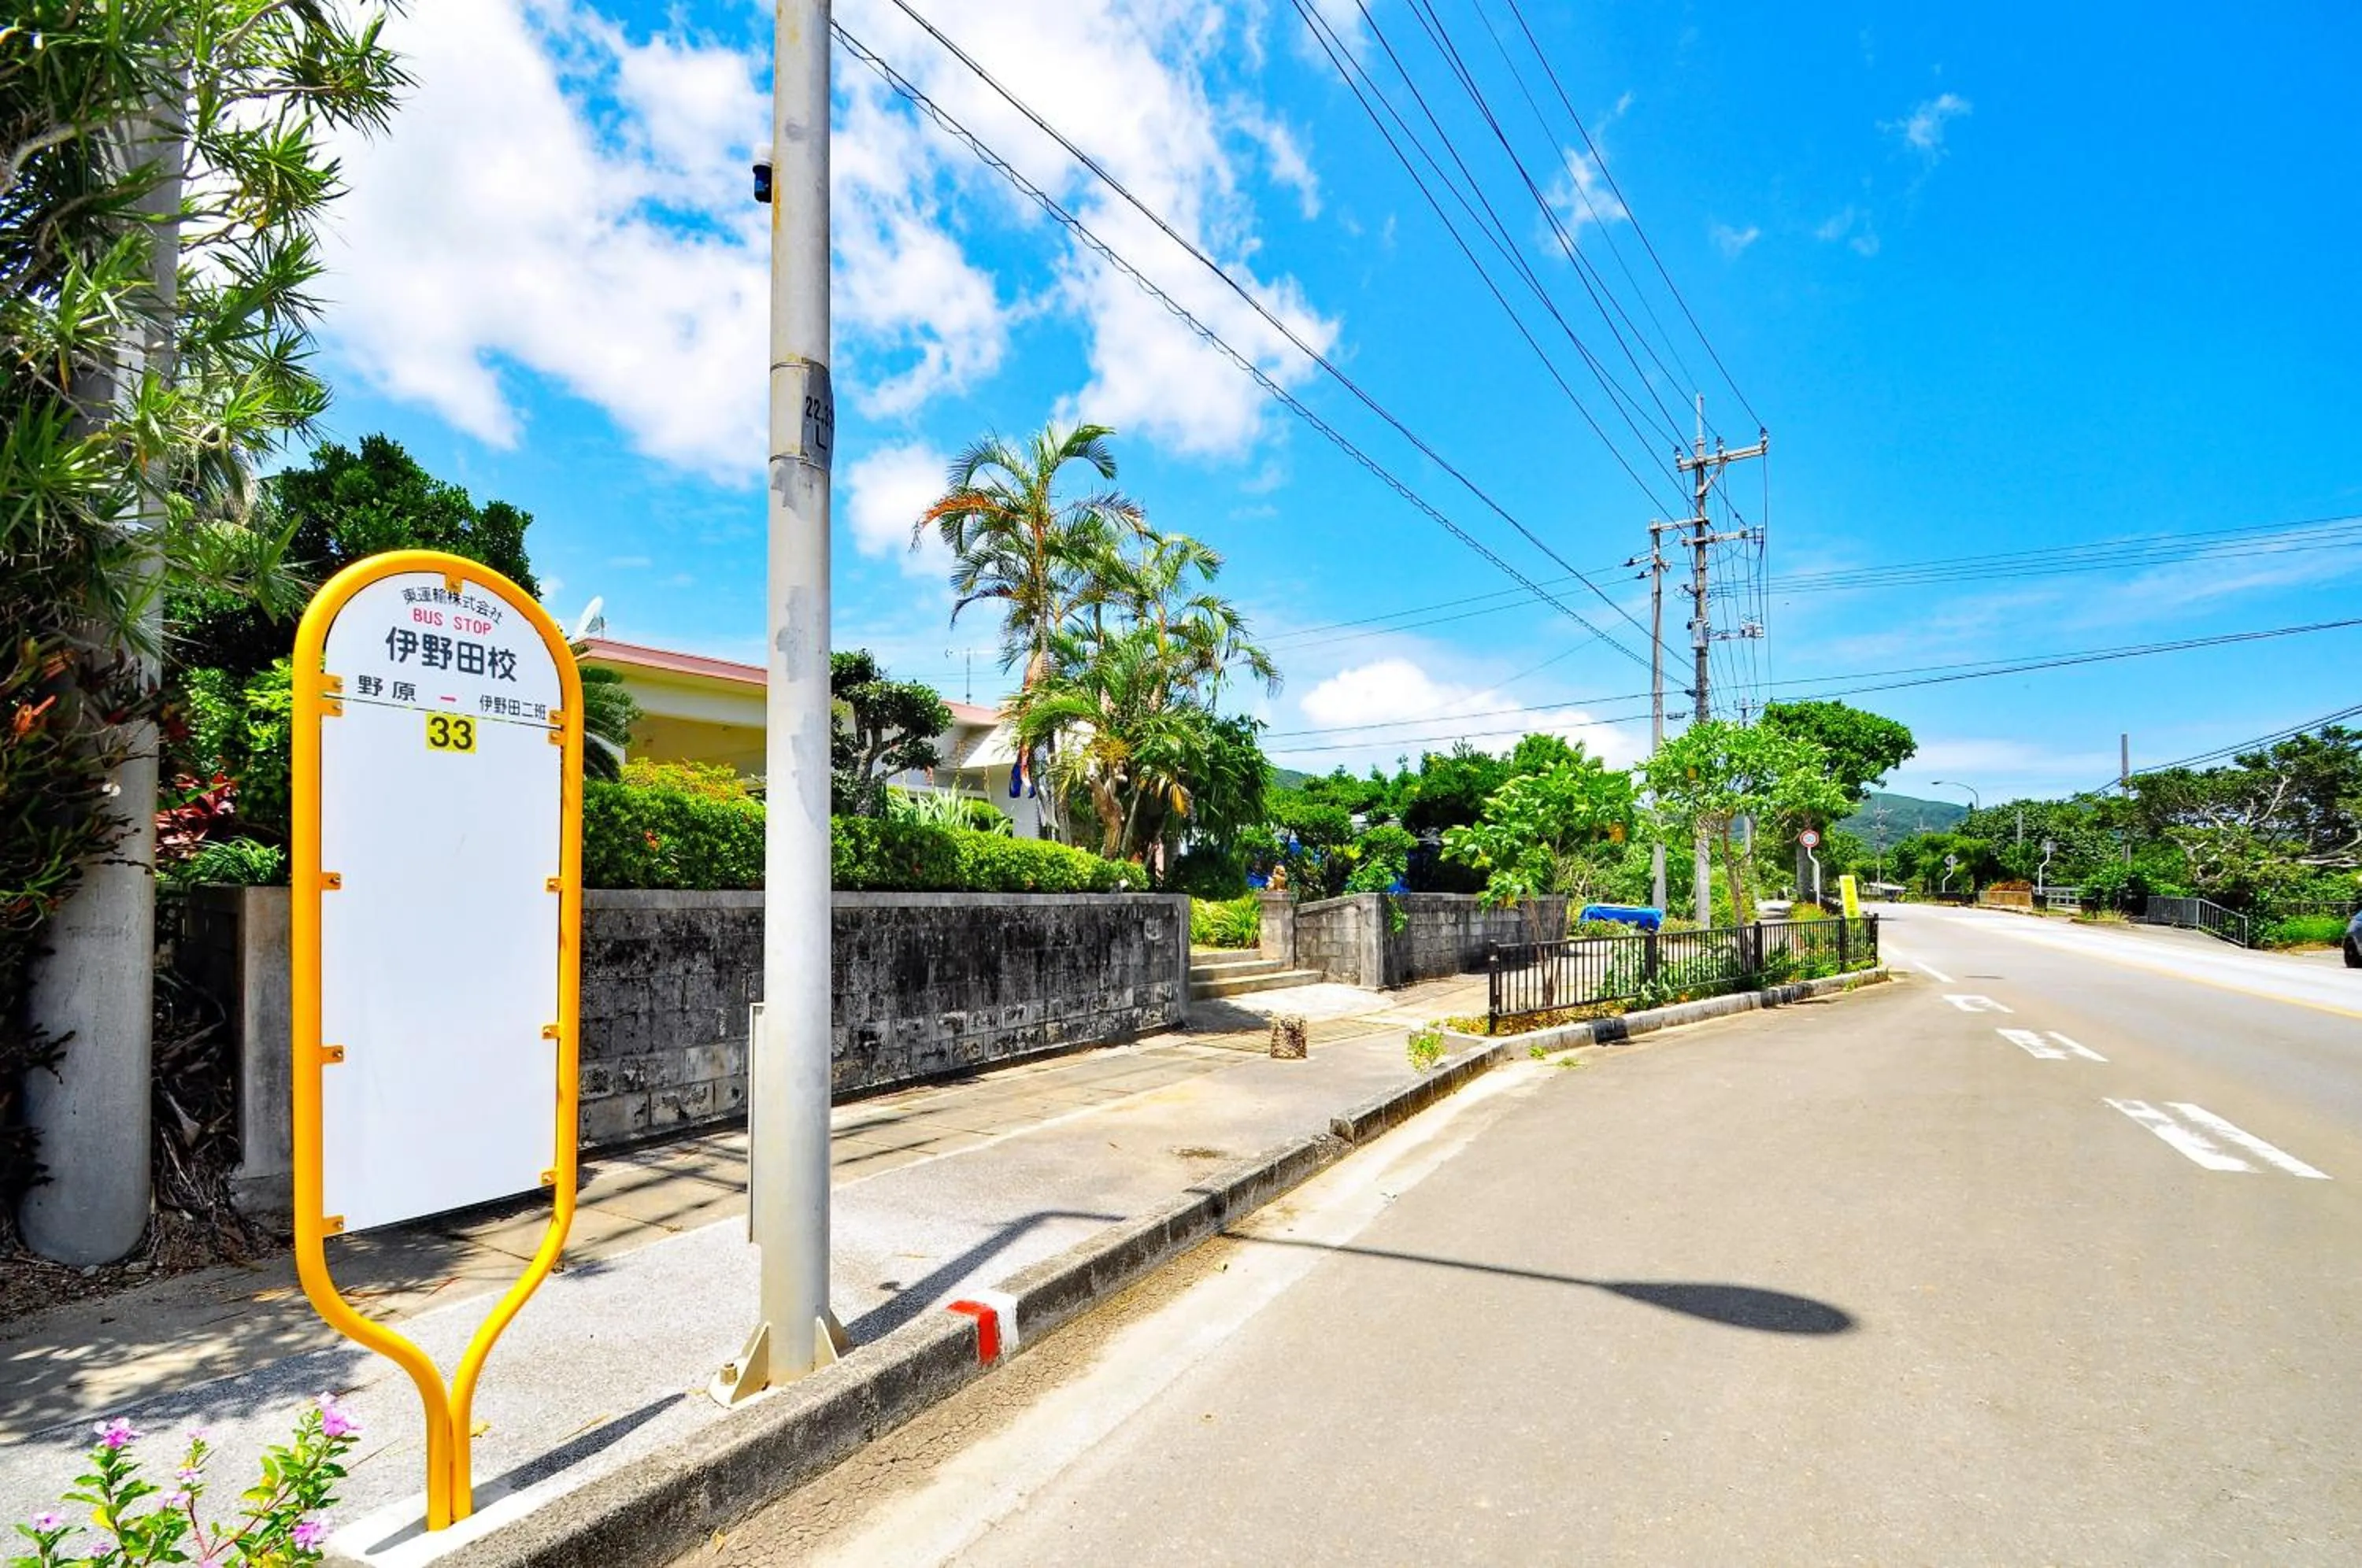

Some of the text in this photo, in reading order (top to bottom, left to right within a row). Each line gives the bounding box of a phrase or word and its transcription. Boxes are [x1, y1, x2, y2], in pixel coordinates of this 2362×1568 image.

[402, 586, 503, 626] 東運輸株式会社
[413, 608, 492, 634] BUS STOP
[385, 626, 517, 682] 伊野田校
[357, 675, 547, 720] 野原 伊野田二班
[429, 716, 472, 750] 33
